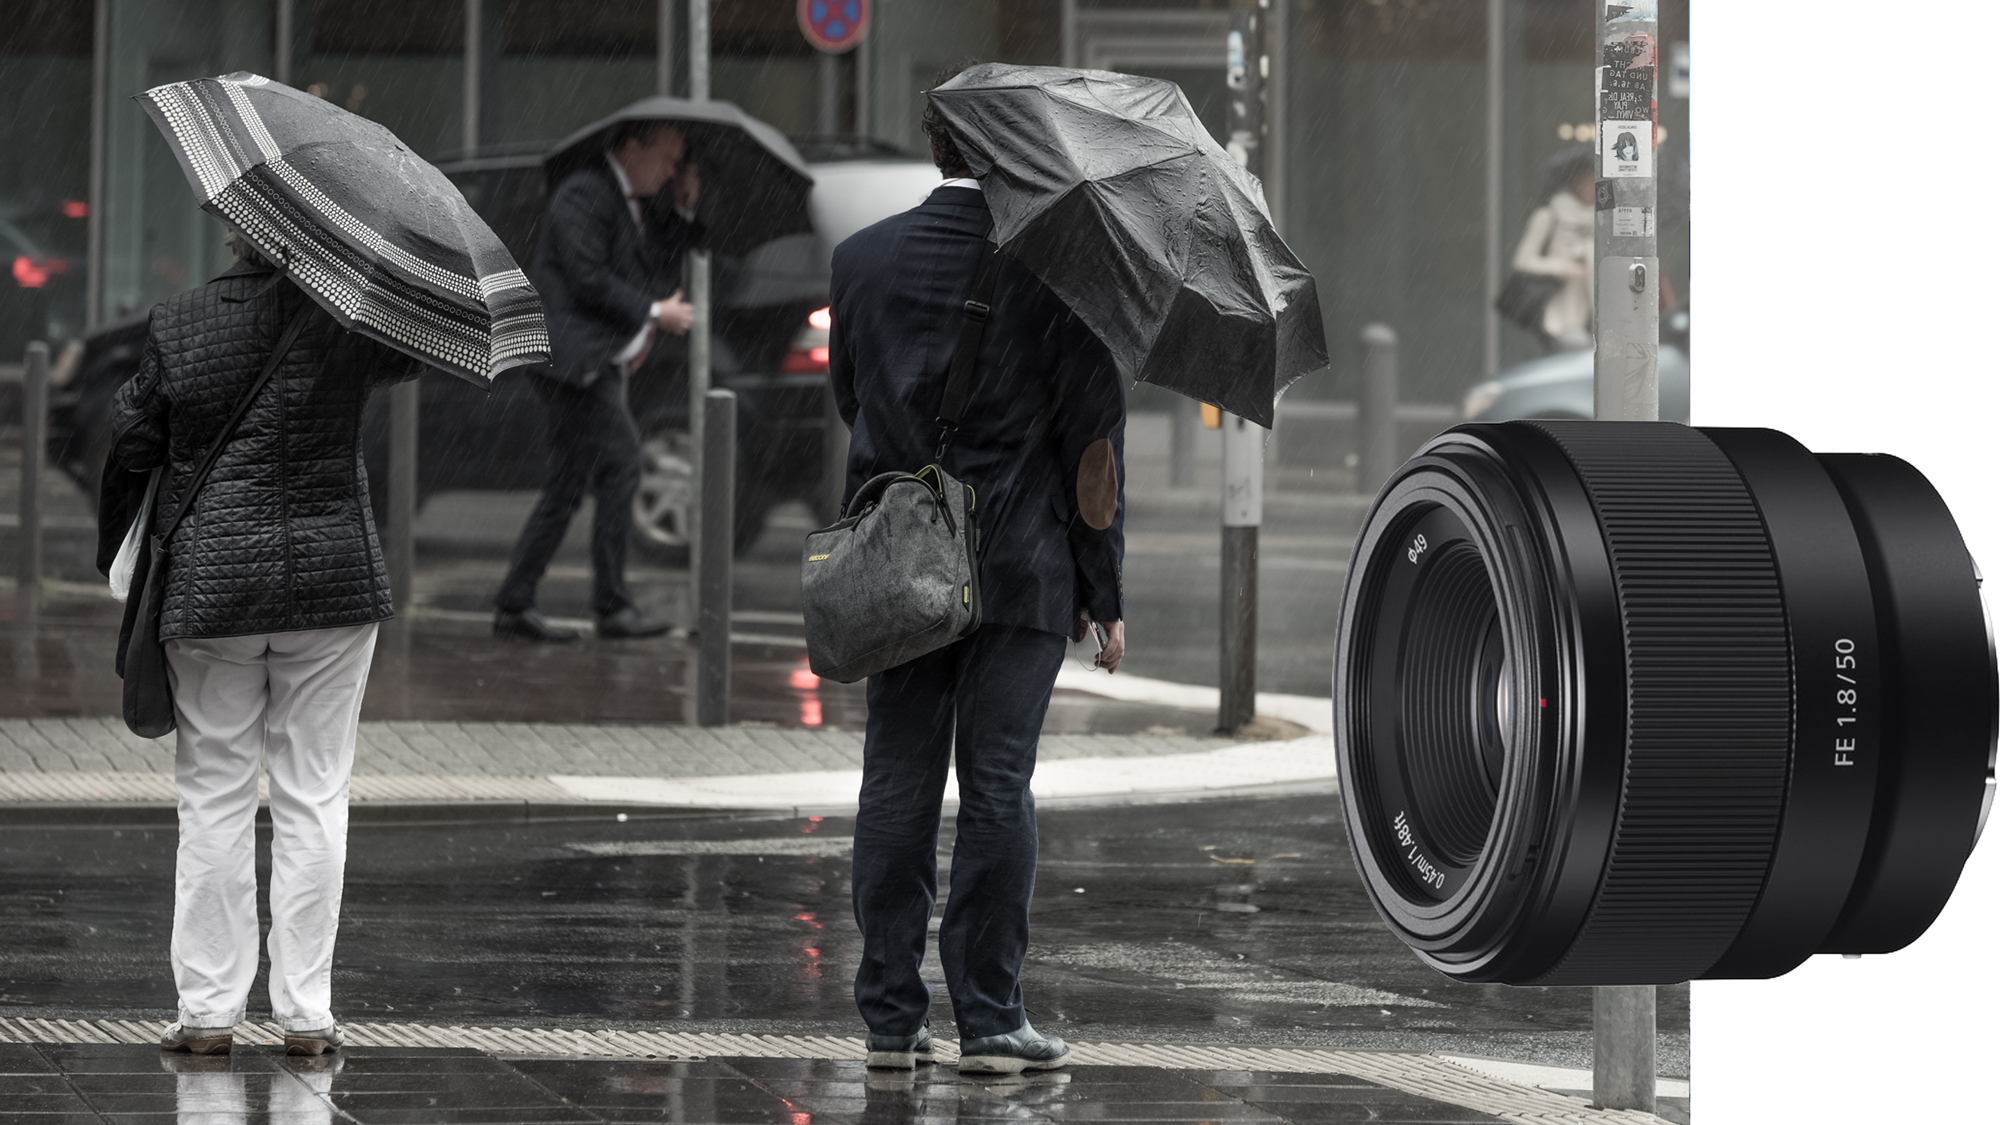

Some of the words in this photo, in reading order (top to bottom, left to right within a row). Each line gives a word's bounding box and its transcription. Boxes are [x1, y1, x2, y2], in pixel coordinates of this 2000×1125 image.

[1834, 638, 1857, 727] 1.8/50
[1834, 738, 1856, 766] FE
[1394, 810, 1446, 890] 0.45m/1.48ft
